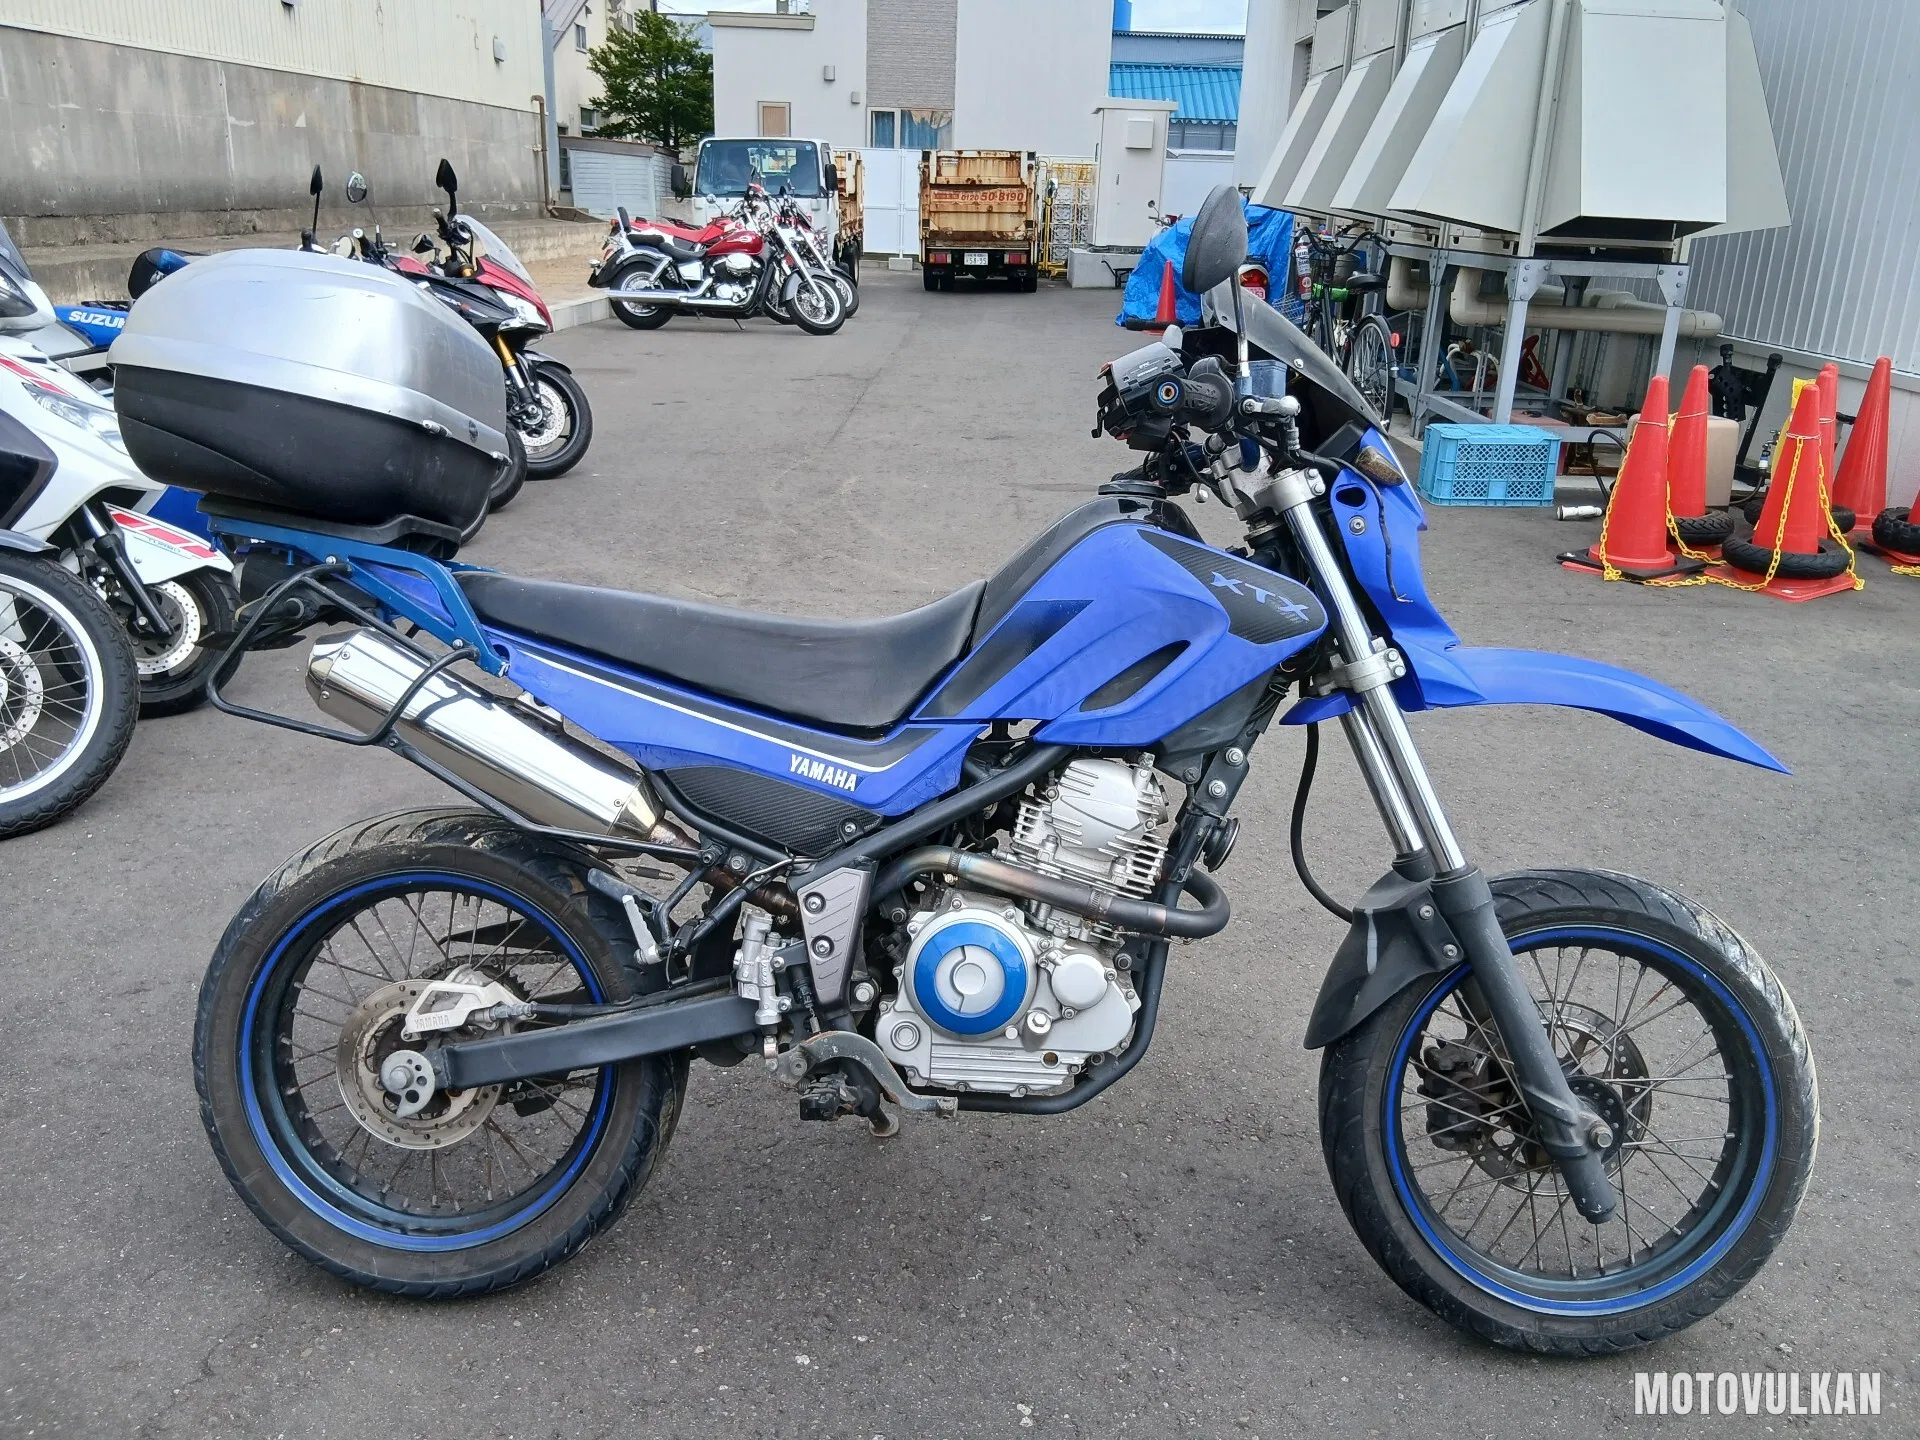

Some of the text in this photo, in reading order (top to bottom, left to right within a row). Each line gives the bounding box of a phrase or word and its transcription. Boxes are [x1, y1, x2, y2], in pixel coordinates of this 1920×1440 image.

[1210, 571, 1310, 621] XTX
[790, 754, 857, 792] YAMAHA
[414, 1014, 450, 1029] YAMAHA
